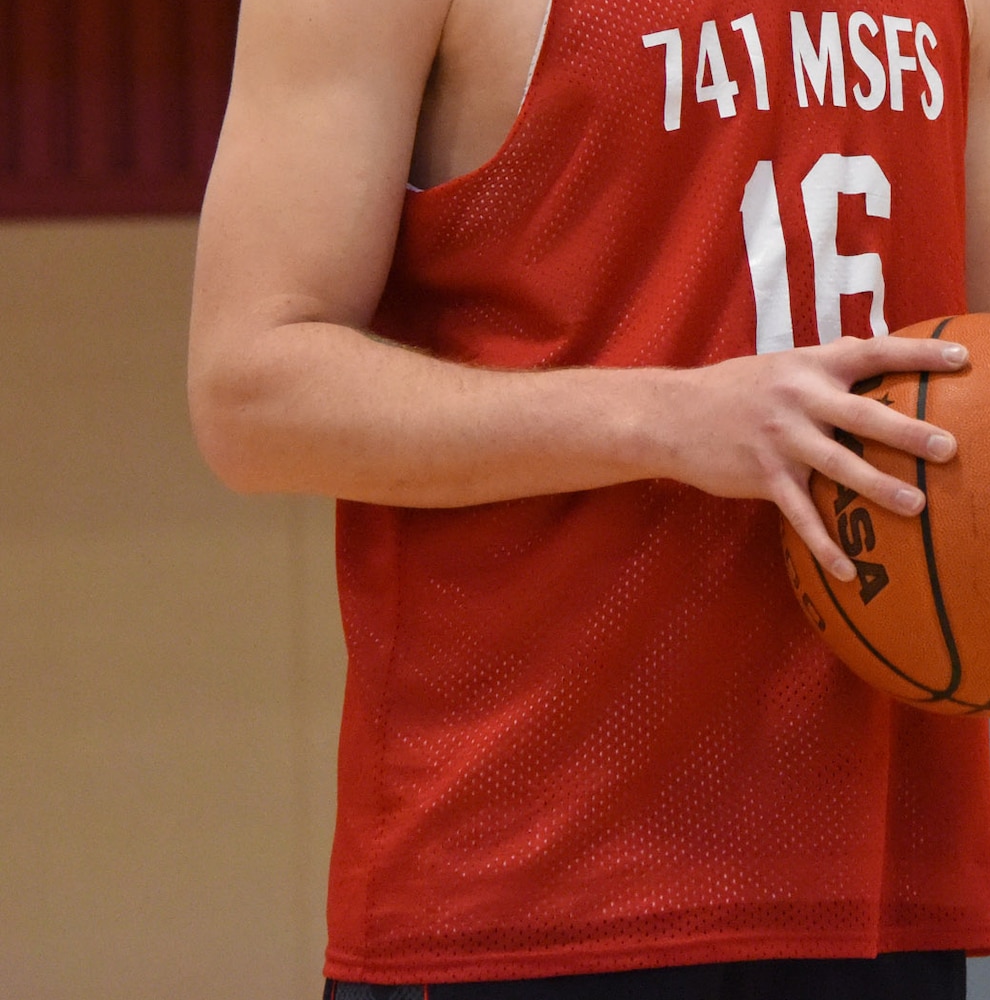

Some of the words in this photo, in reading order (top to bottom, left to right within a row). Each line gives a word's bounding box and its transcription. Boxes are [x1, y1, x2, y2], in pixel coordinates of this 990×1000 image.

[642, 12, 770, 131] 741
[790, 11, 944, 121] MSFS
[739, 153, 891, 355] 16
